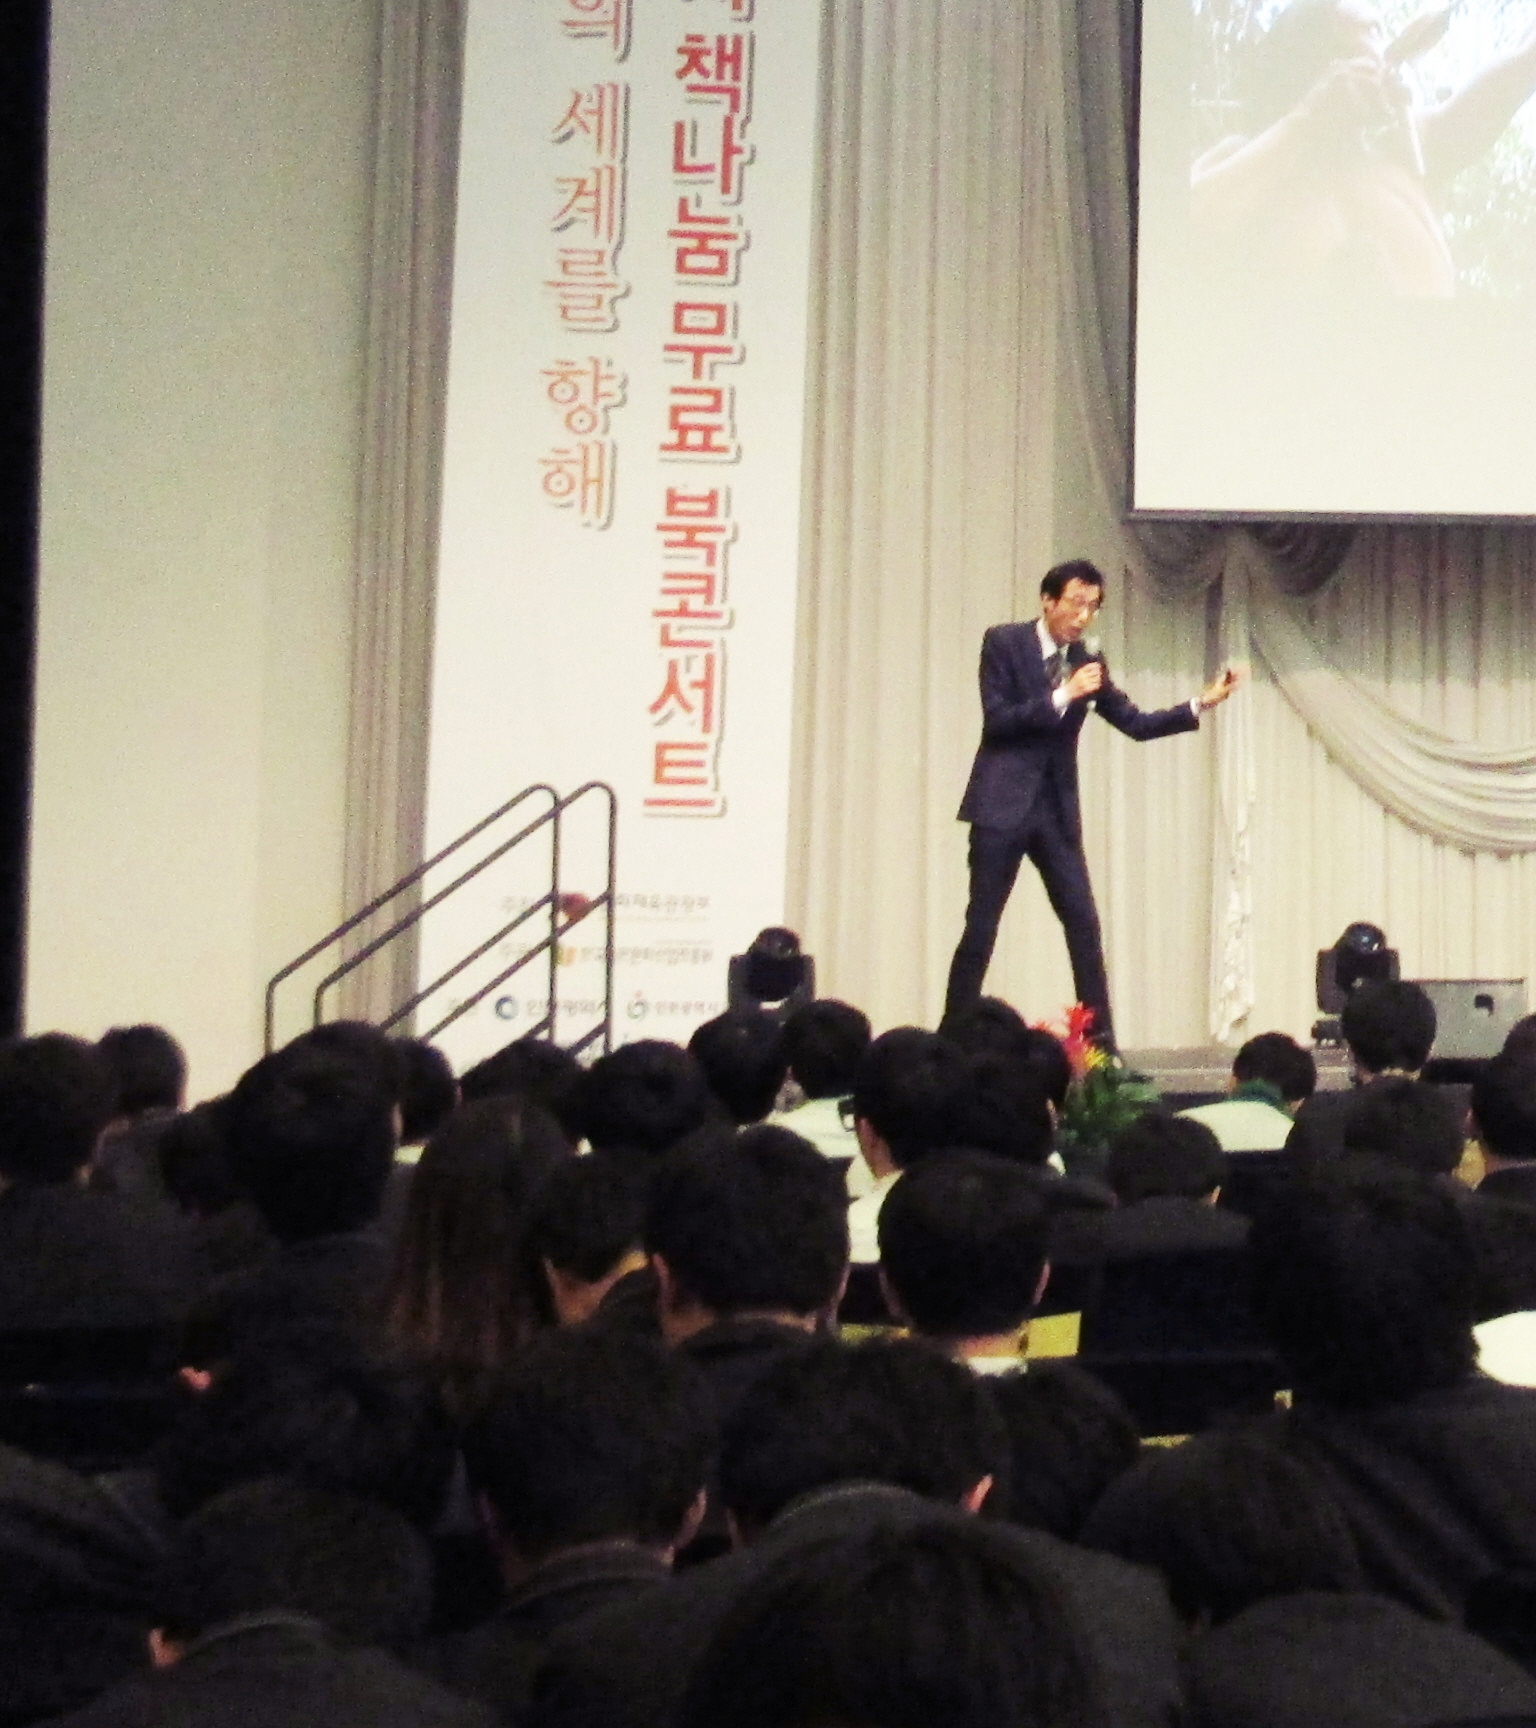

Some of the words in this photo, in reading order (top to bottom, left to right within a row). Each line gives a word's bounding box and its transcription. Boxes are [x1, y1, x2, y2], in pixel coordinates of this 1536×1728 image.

[544, 82, 626, 328] 세계를
[667, 33, 750, 282] 책나눔
[537, 355, 622, 524] 향해
[659, 301, 740, 459] 무료
[643, 485, 732, 812] 북콘서트
